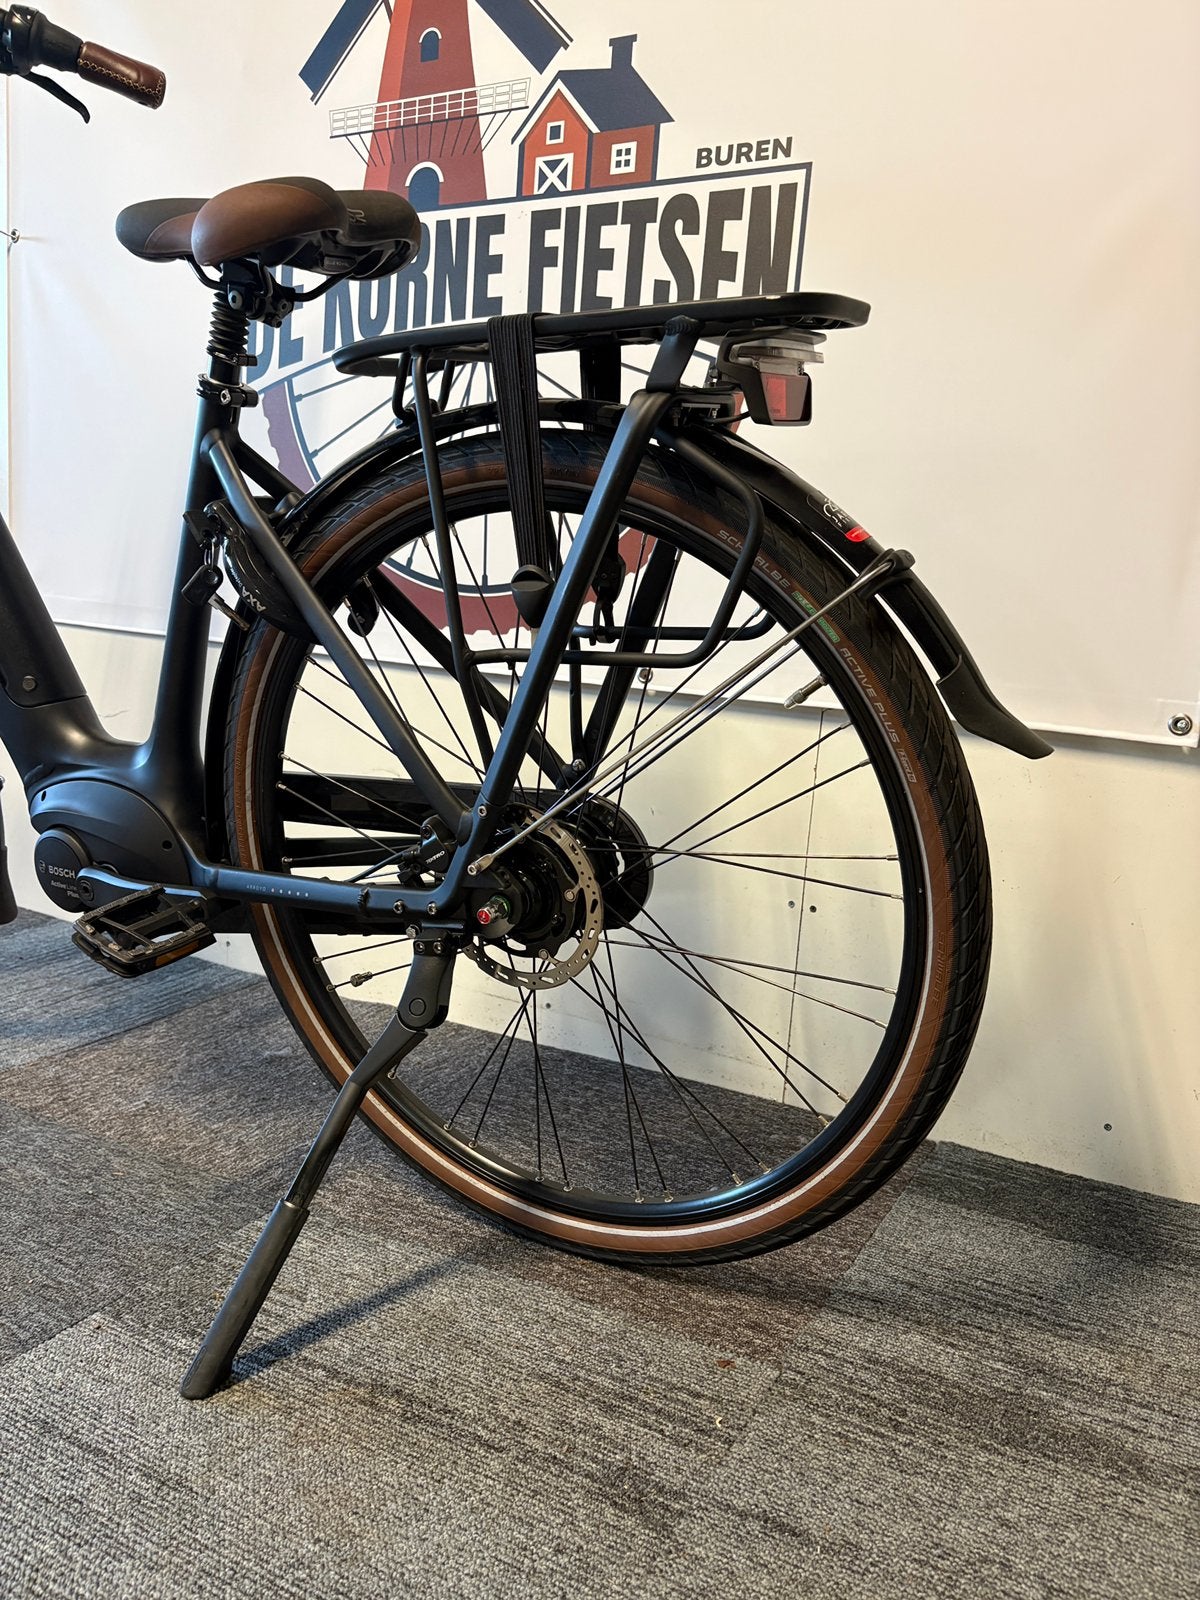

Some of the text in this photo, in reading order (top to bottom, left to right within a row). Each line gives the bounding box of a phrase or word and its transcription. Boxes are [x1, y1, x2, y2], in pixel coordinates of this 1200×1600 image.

[695, 136, 793, 169] BUREN
[322, 213, 506, 354] KORNE
[526, 182, 798, 315] FIETSEN
[241, 585, 267, 612] AXA
[716, 529, 901, 744] SCHALBE ACTIVE PLUS
[48, 865, 76, 879] BOSCH
